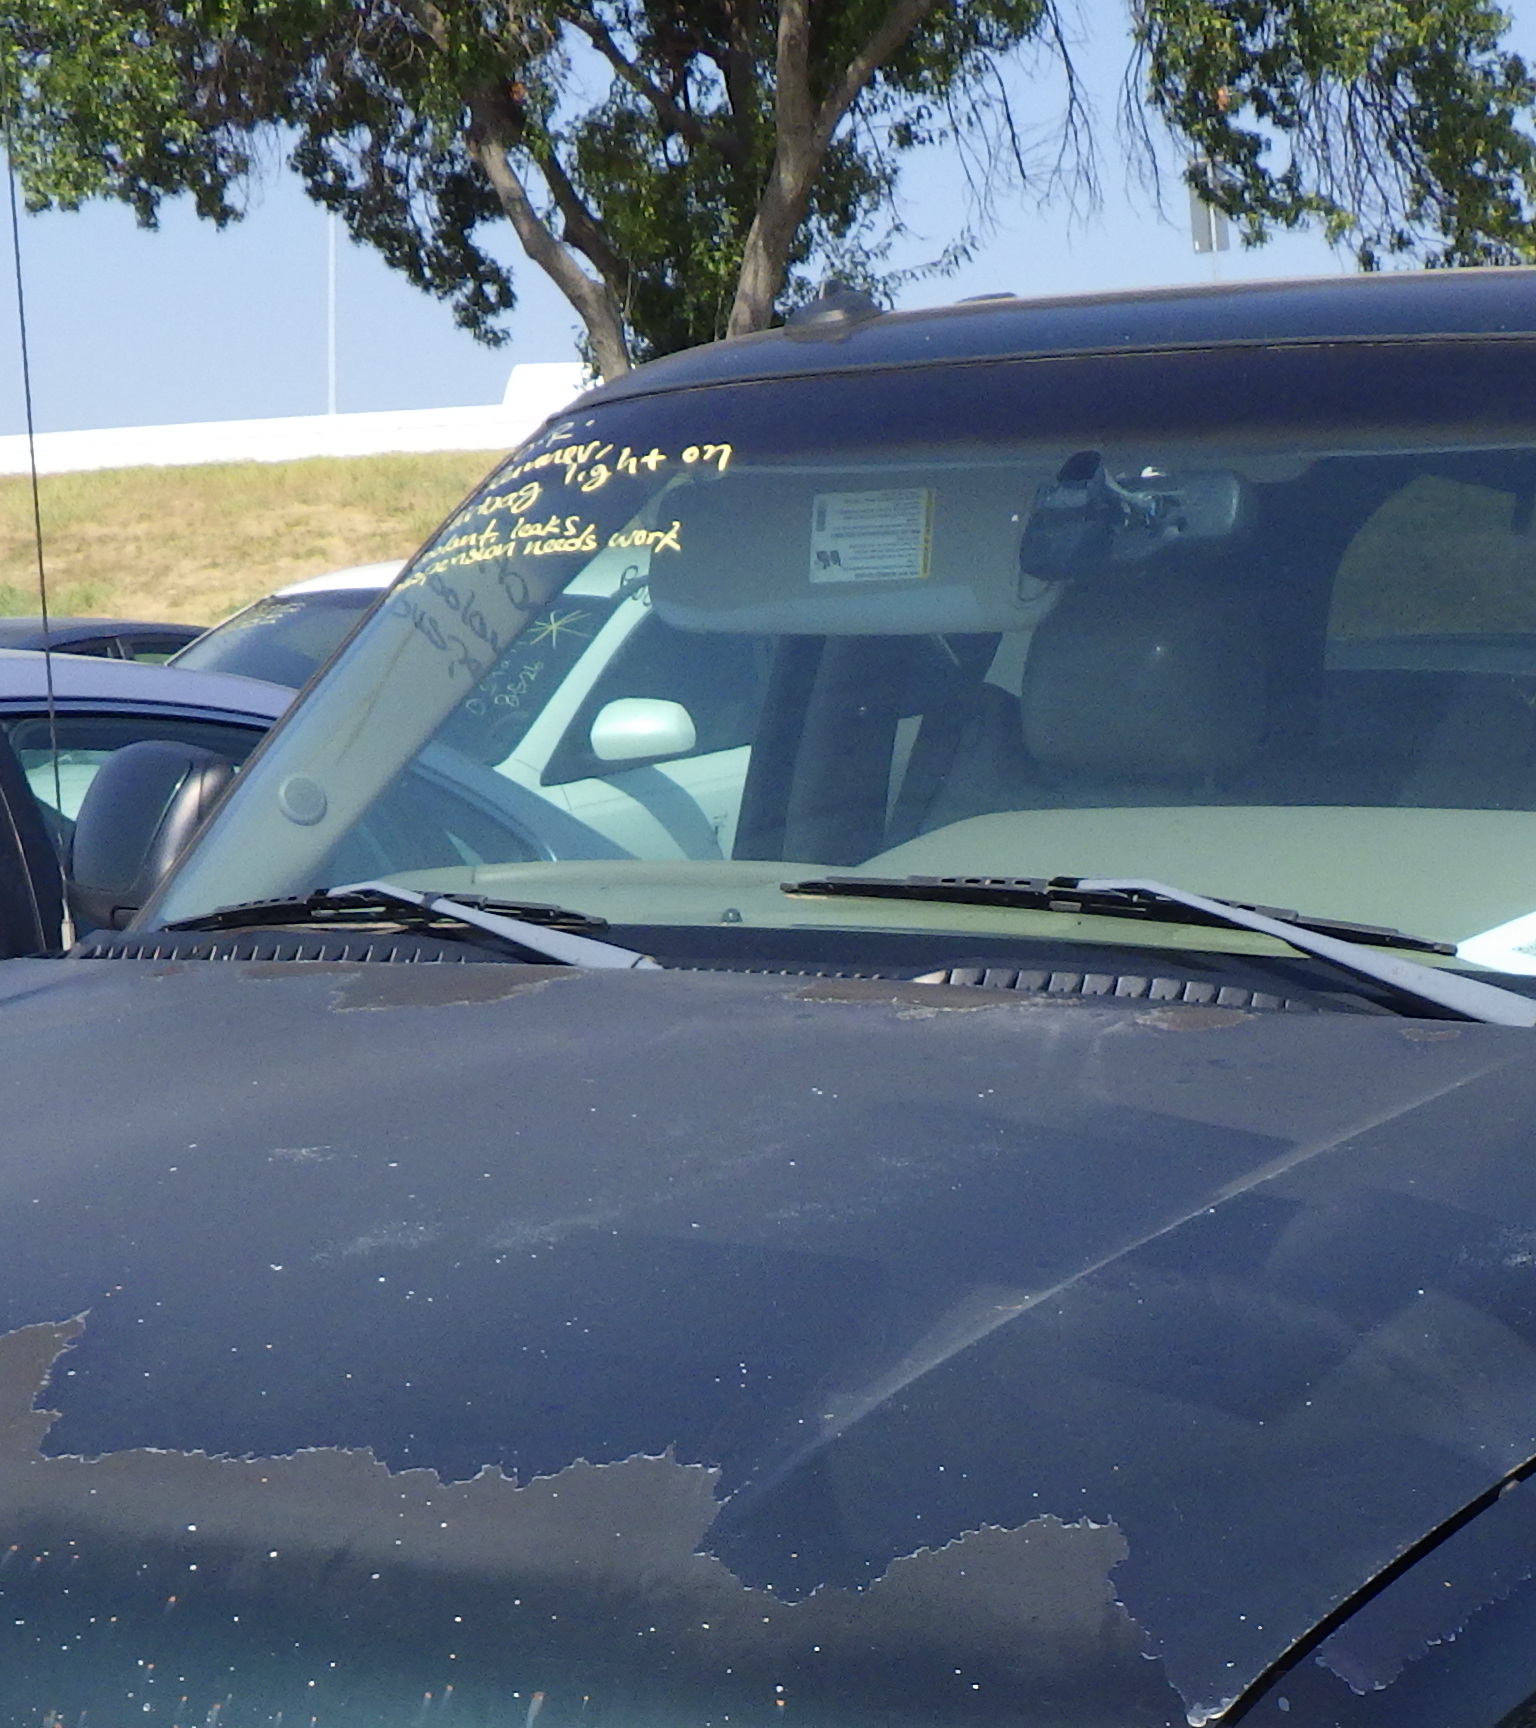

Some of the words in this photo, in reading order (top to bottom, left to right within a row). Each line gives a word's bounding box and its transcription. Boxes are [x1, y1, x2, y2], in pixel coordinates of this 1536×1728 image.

[564, 446, 667, 492] light
[682, 443, 733, 471] on
[524, 524, 599, 557] needs
[608, 520, 683, 554] work
